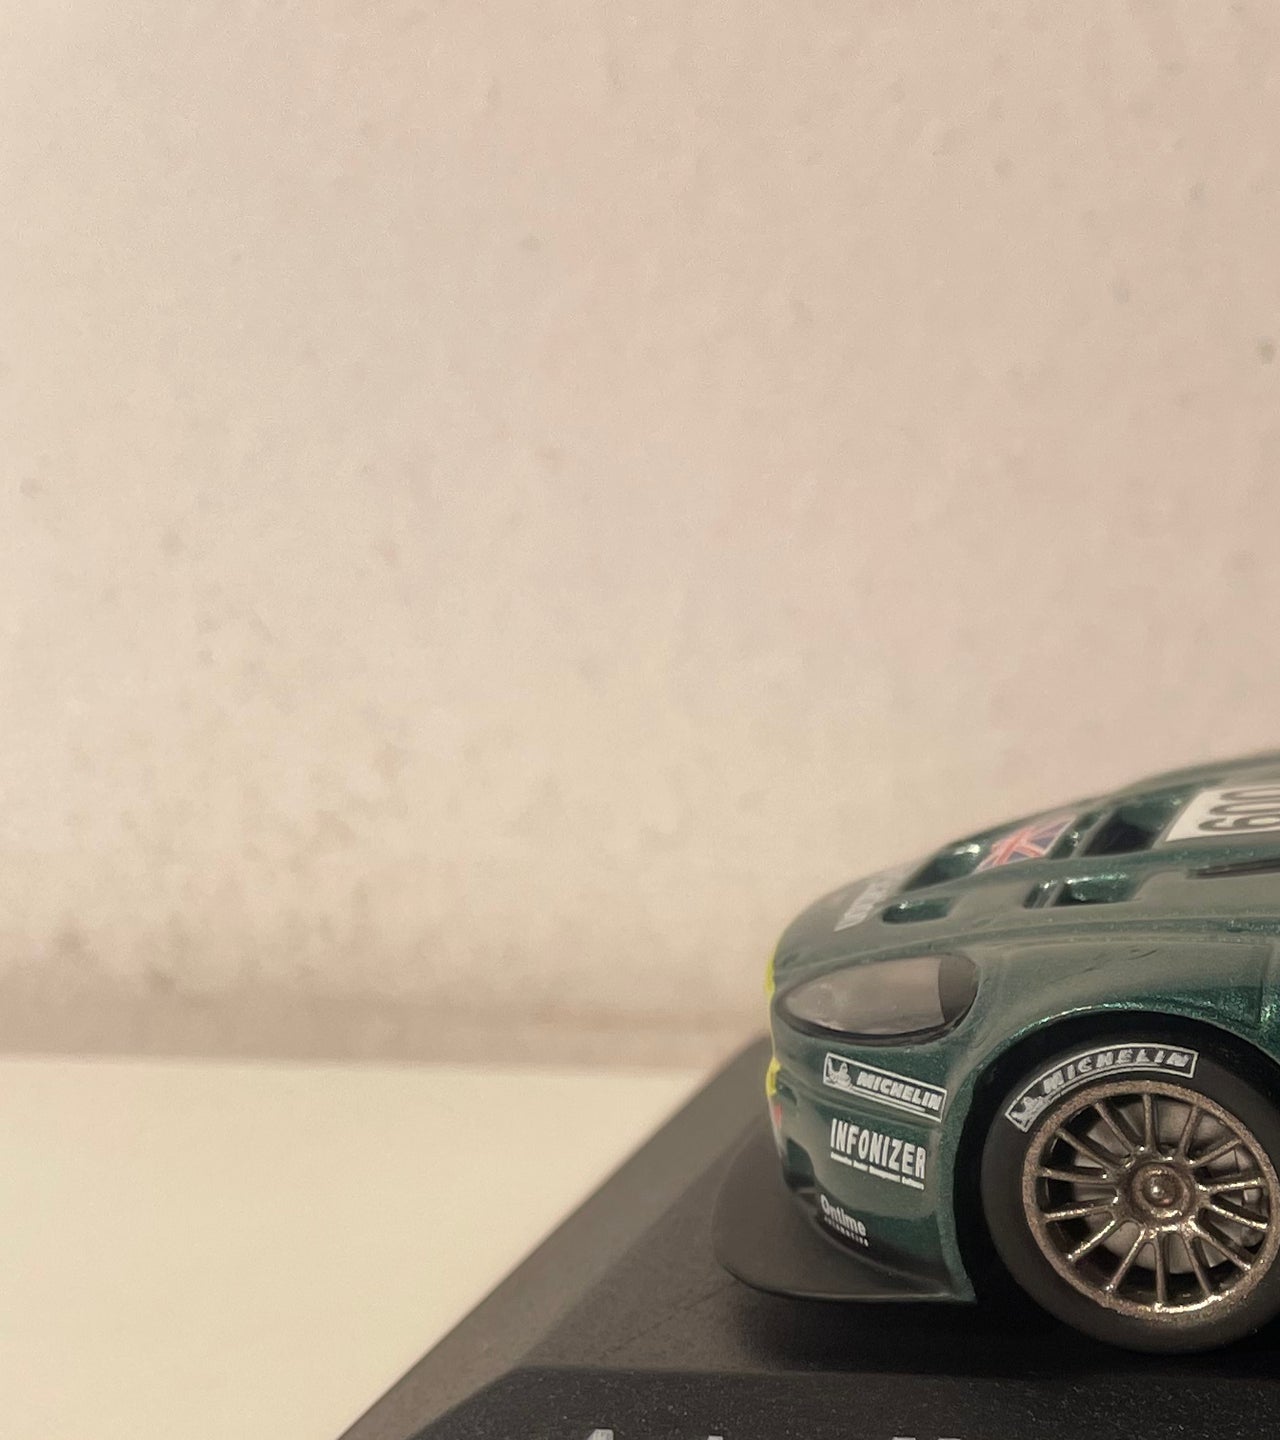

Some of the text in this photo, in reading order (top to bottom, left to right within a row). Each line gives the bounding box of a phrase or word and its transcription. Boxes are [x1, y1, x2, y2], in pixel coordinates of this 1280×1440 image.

[857, 1071, 943, 1111] MICHELIN
[1043, 1048, 1191, 1096] MICHELIN
[830, 1118, 928, 1180] INFONIZER
